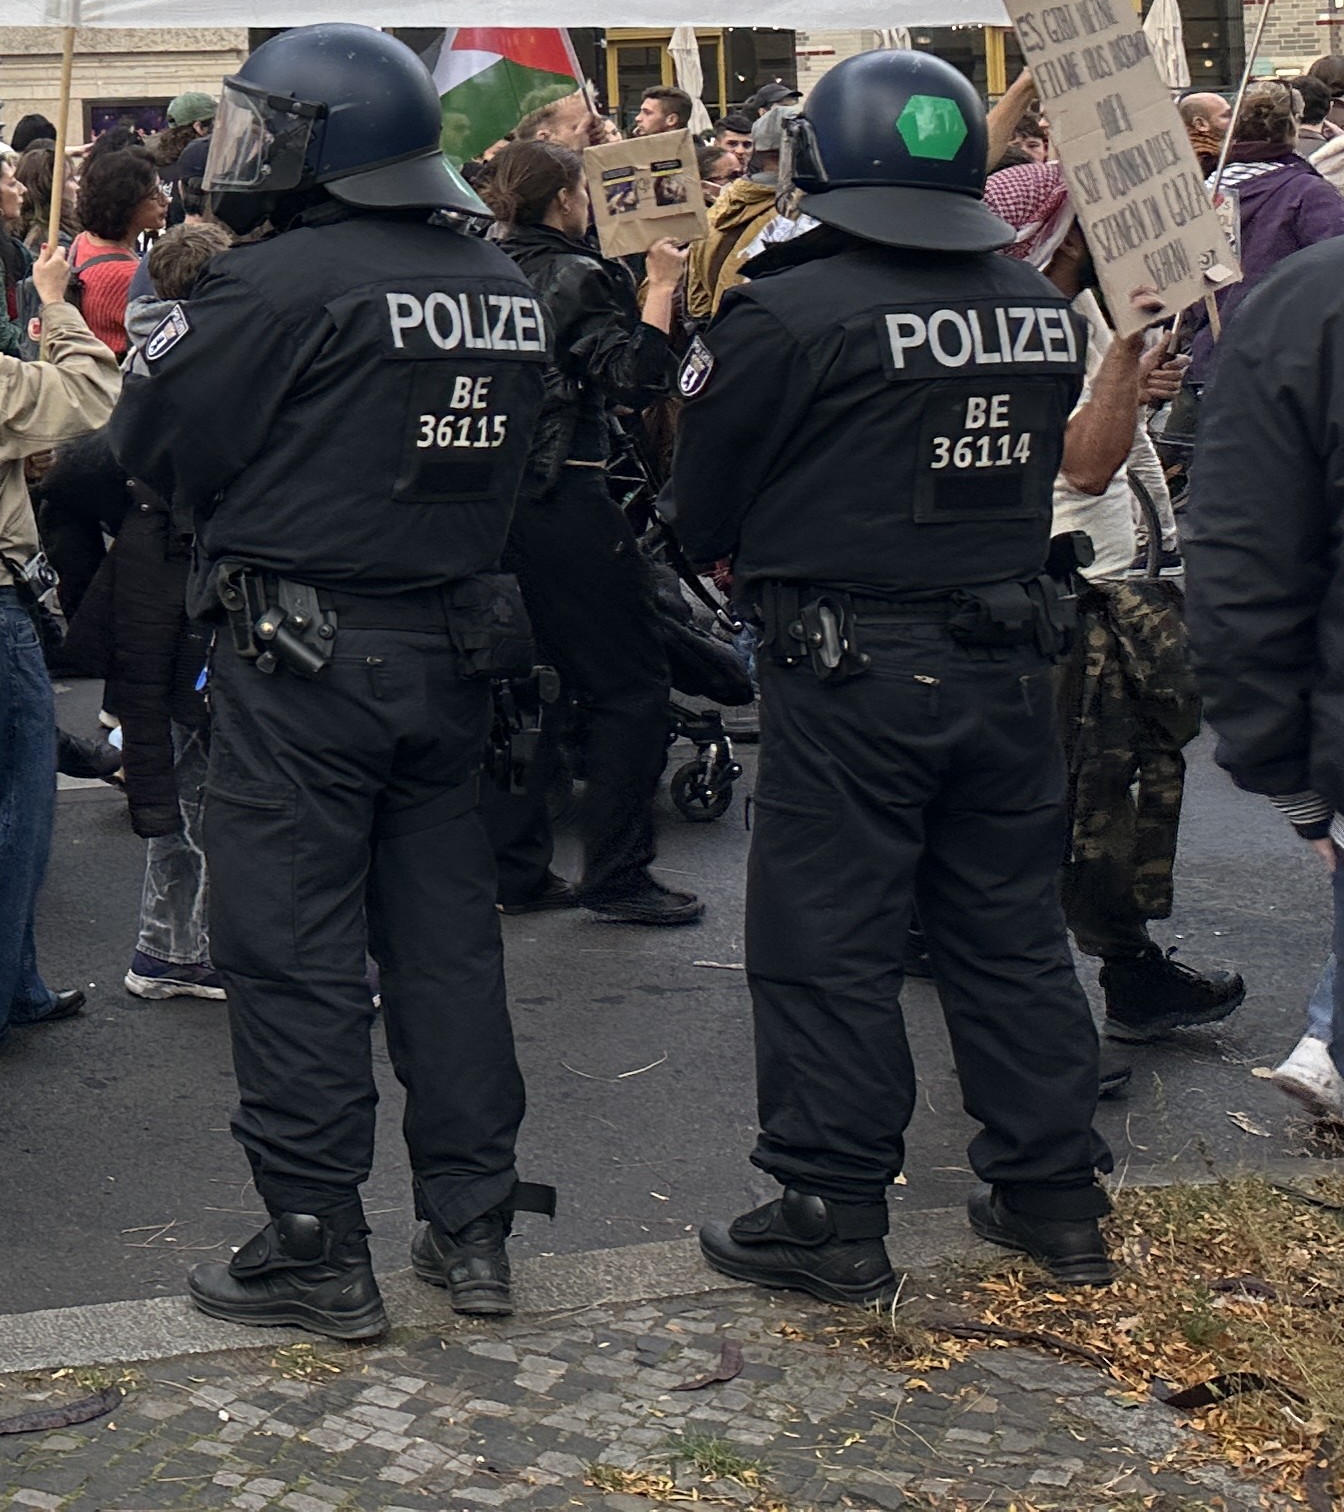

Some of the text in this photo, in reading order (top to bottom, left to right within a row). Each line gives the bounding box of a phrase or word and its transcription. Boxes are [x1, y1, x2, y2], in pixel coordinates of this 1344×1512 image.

[1016, 12, 1045, 52] ES
[385, 292, 547, 353] POLIZEI
[884, 307, 1077, 369] POLIZEI
[449, 376, 492, 409] BE
[964, 394, 1010, 429] BE
[416, 415, 508, 448] 36115
[930, 432, 1031, 469] 36114
